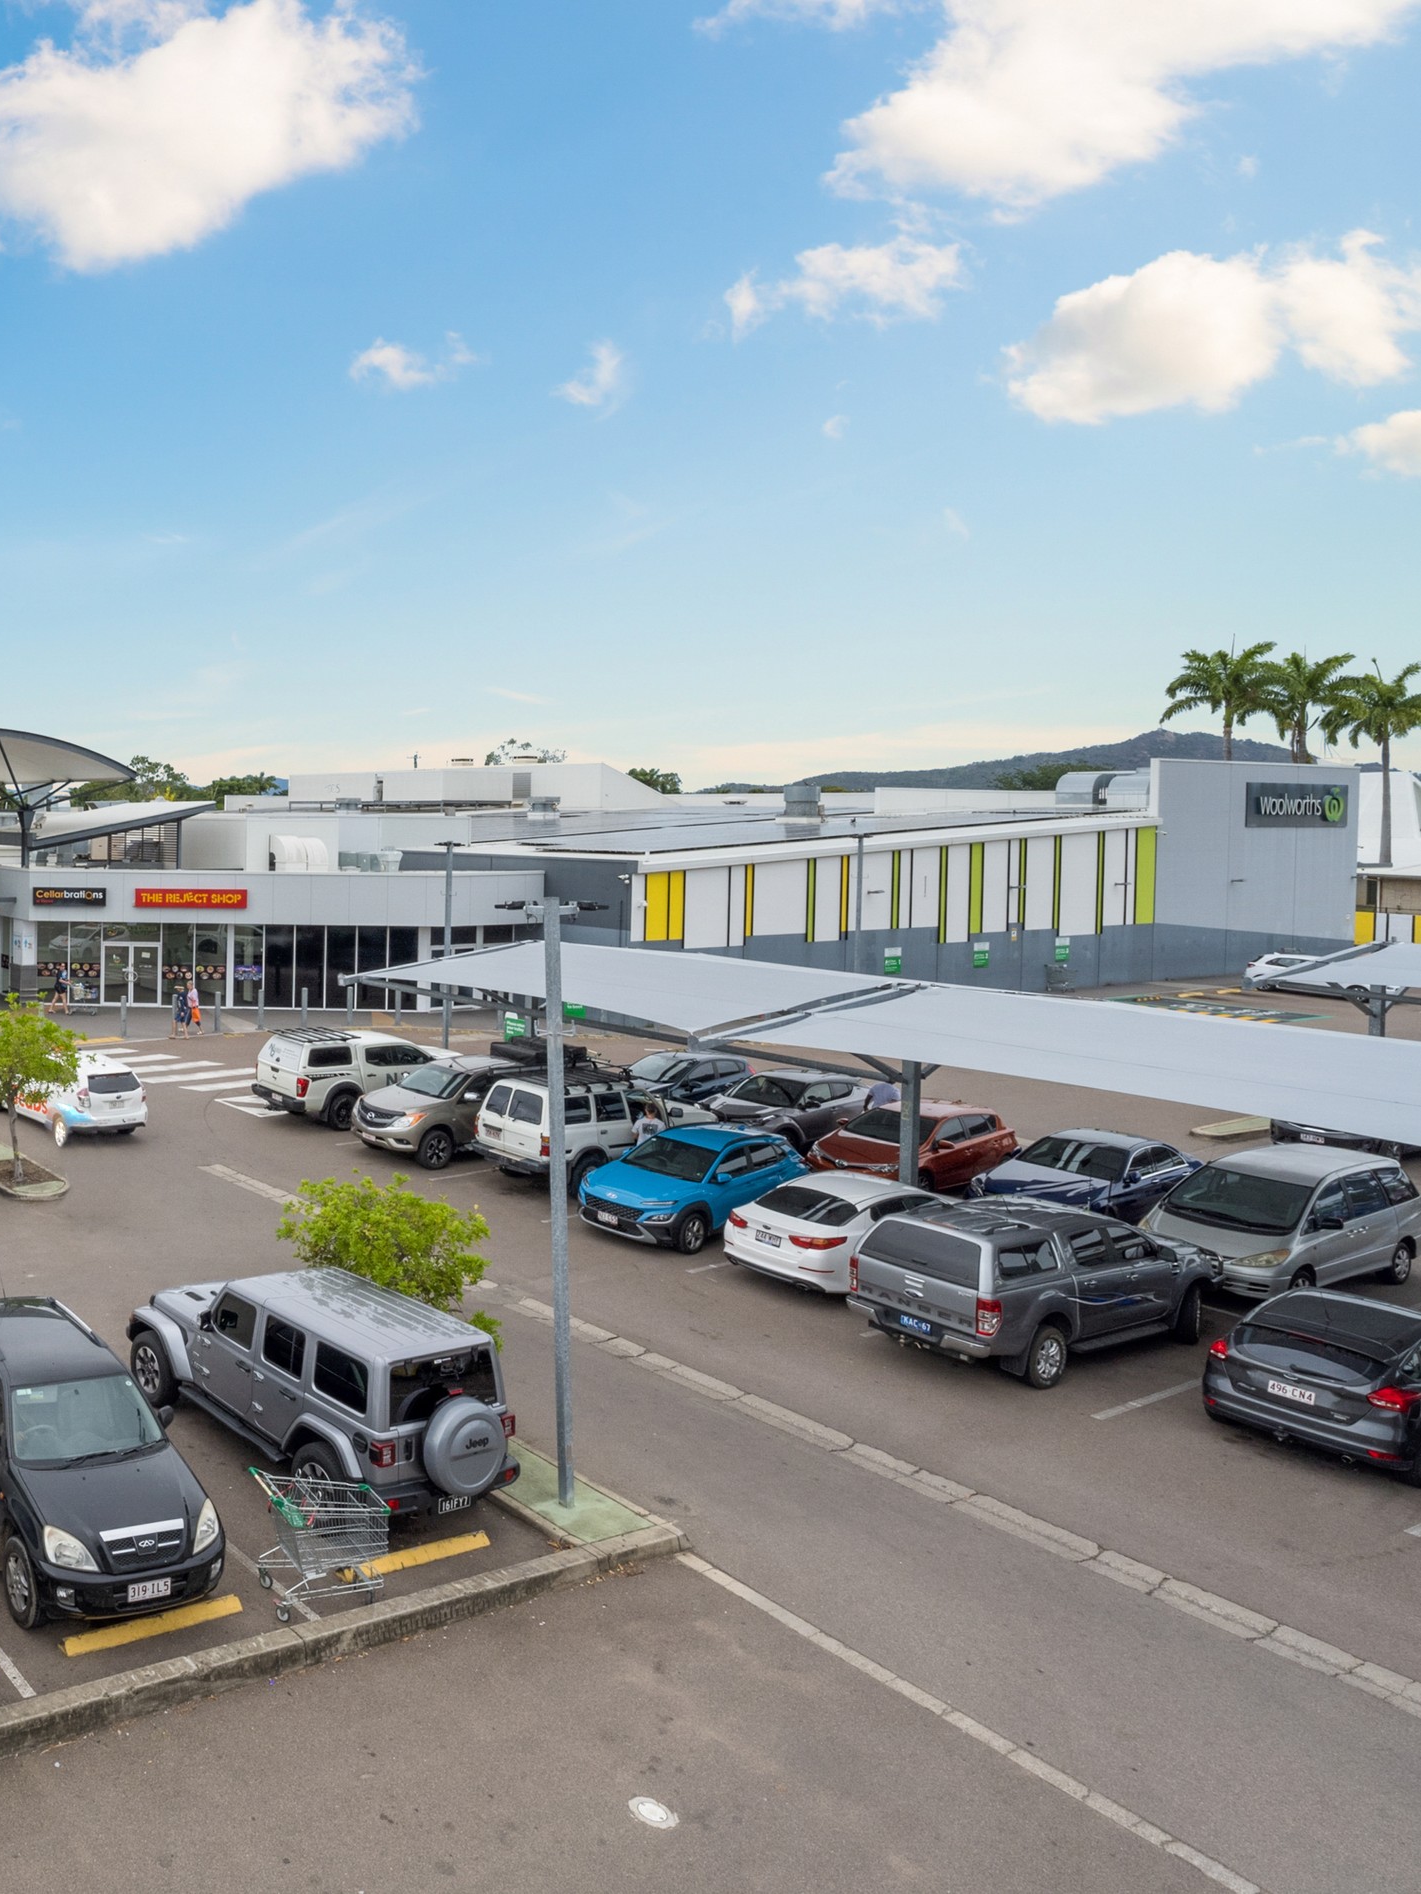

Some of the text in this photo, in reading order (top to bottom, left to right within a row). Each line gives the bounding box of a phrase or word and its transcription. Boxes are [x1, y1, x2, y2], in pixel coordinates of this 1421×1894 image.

[1260, 793, 1322, 815] Woolworths
[36, 890, 103, 900] Cellarbrations
[141, 892, 242, 903] THE REJECT SHOP
[465, 1437, 489, 1449] Jeep
